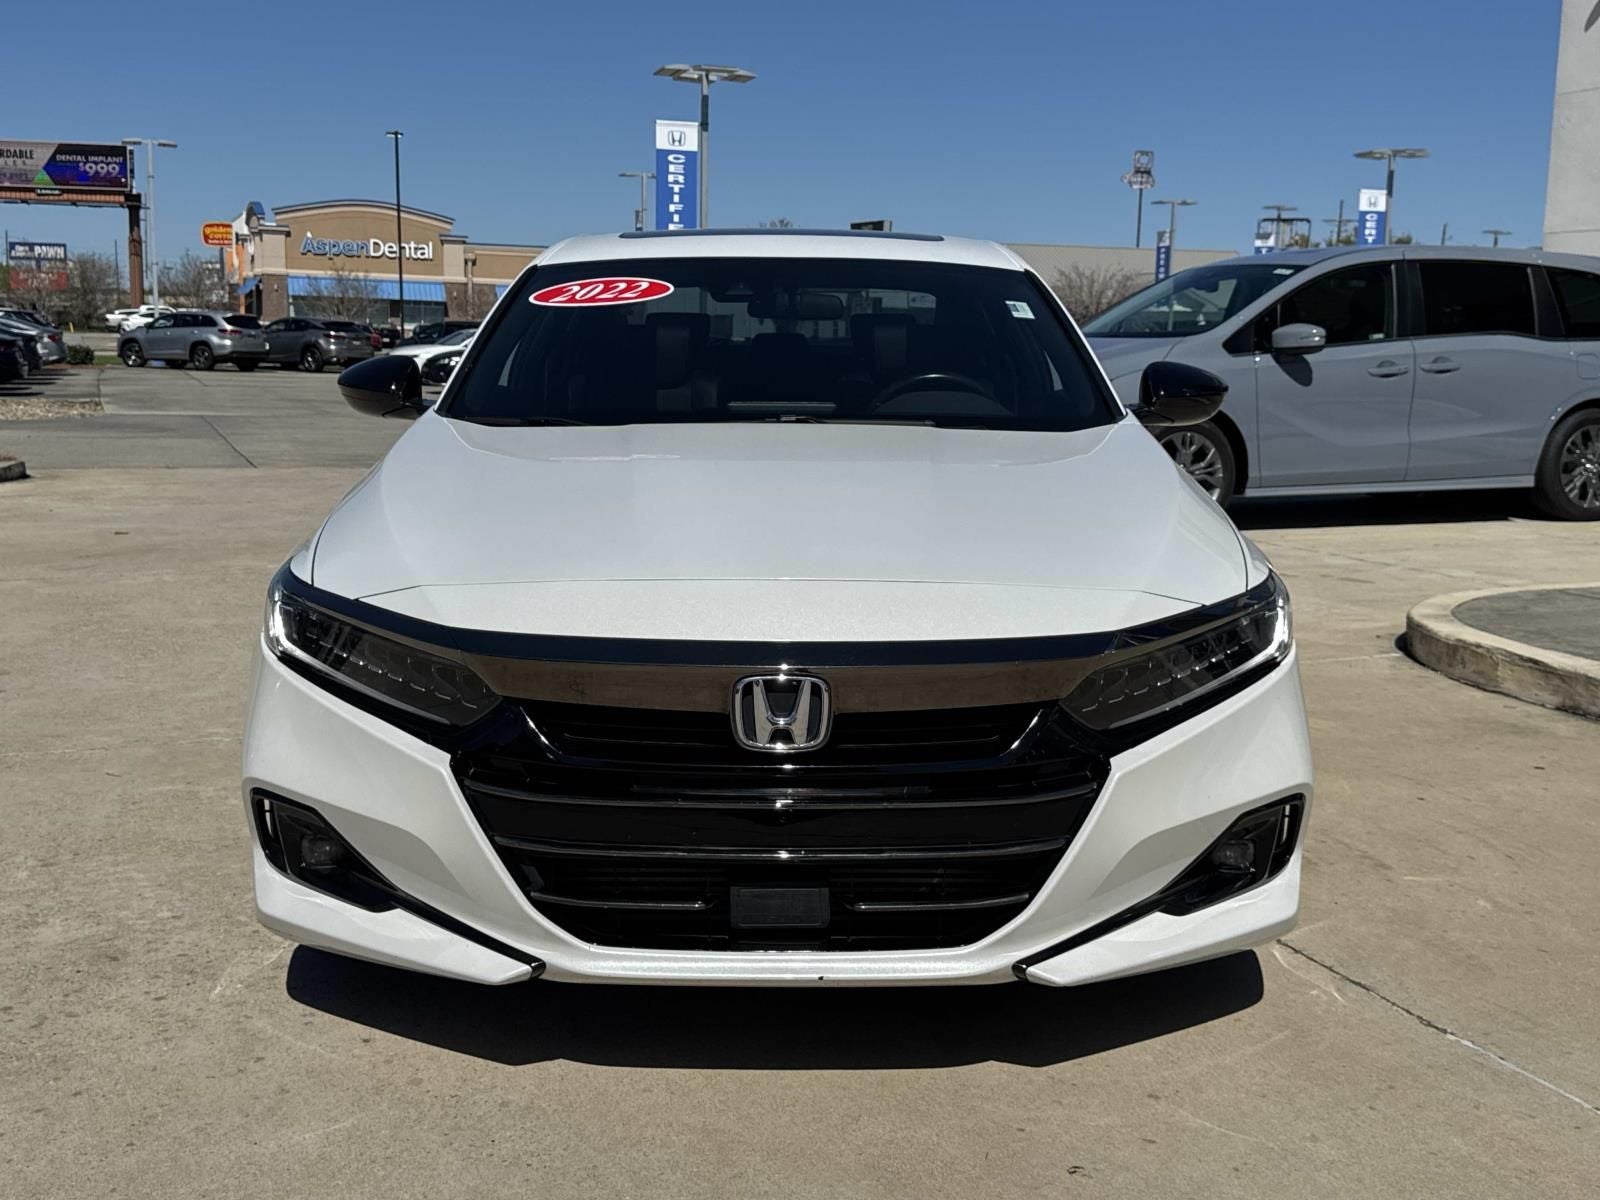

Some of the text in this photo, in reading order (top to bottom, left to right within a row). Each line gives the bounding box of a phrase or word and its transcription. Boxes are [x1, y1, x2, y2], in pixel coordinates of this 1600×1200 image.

[56, 154, 87, 162] DENTAL
[88, 155, 124, 164] IMPLANT
[78, 162, 120, 177] $999
[34, 245, 65, 259] PAWN
[548, 281, 650, 303] 2022
